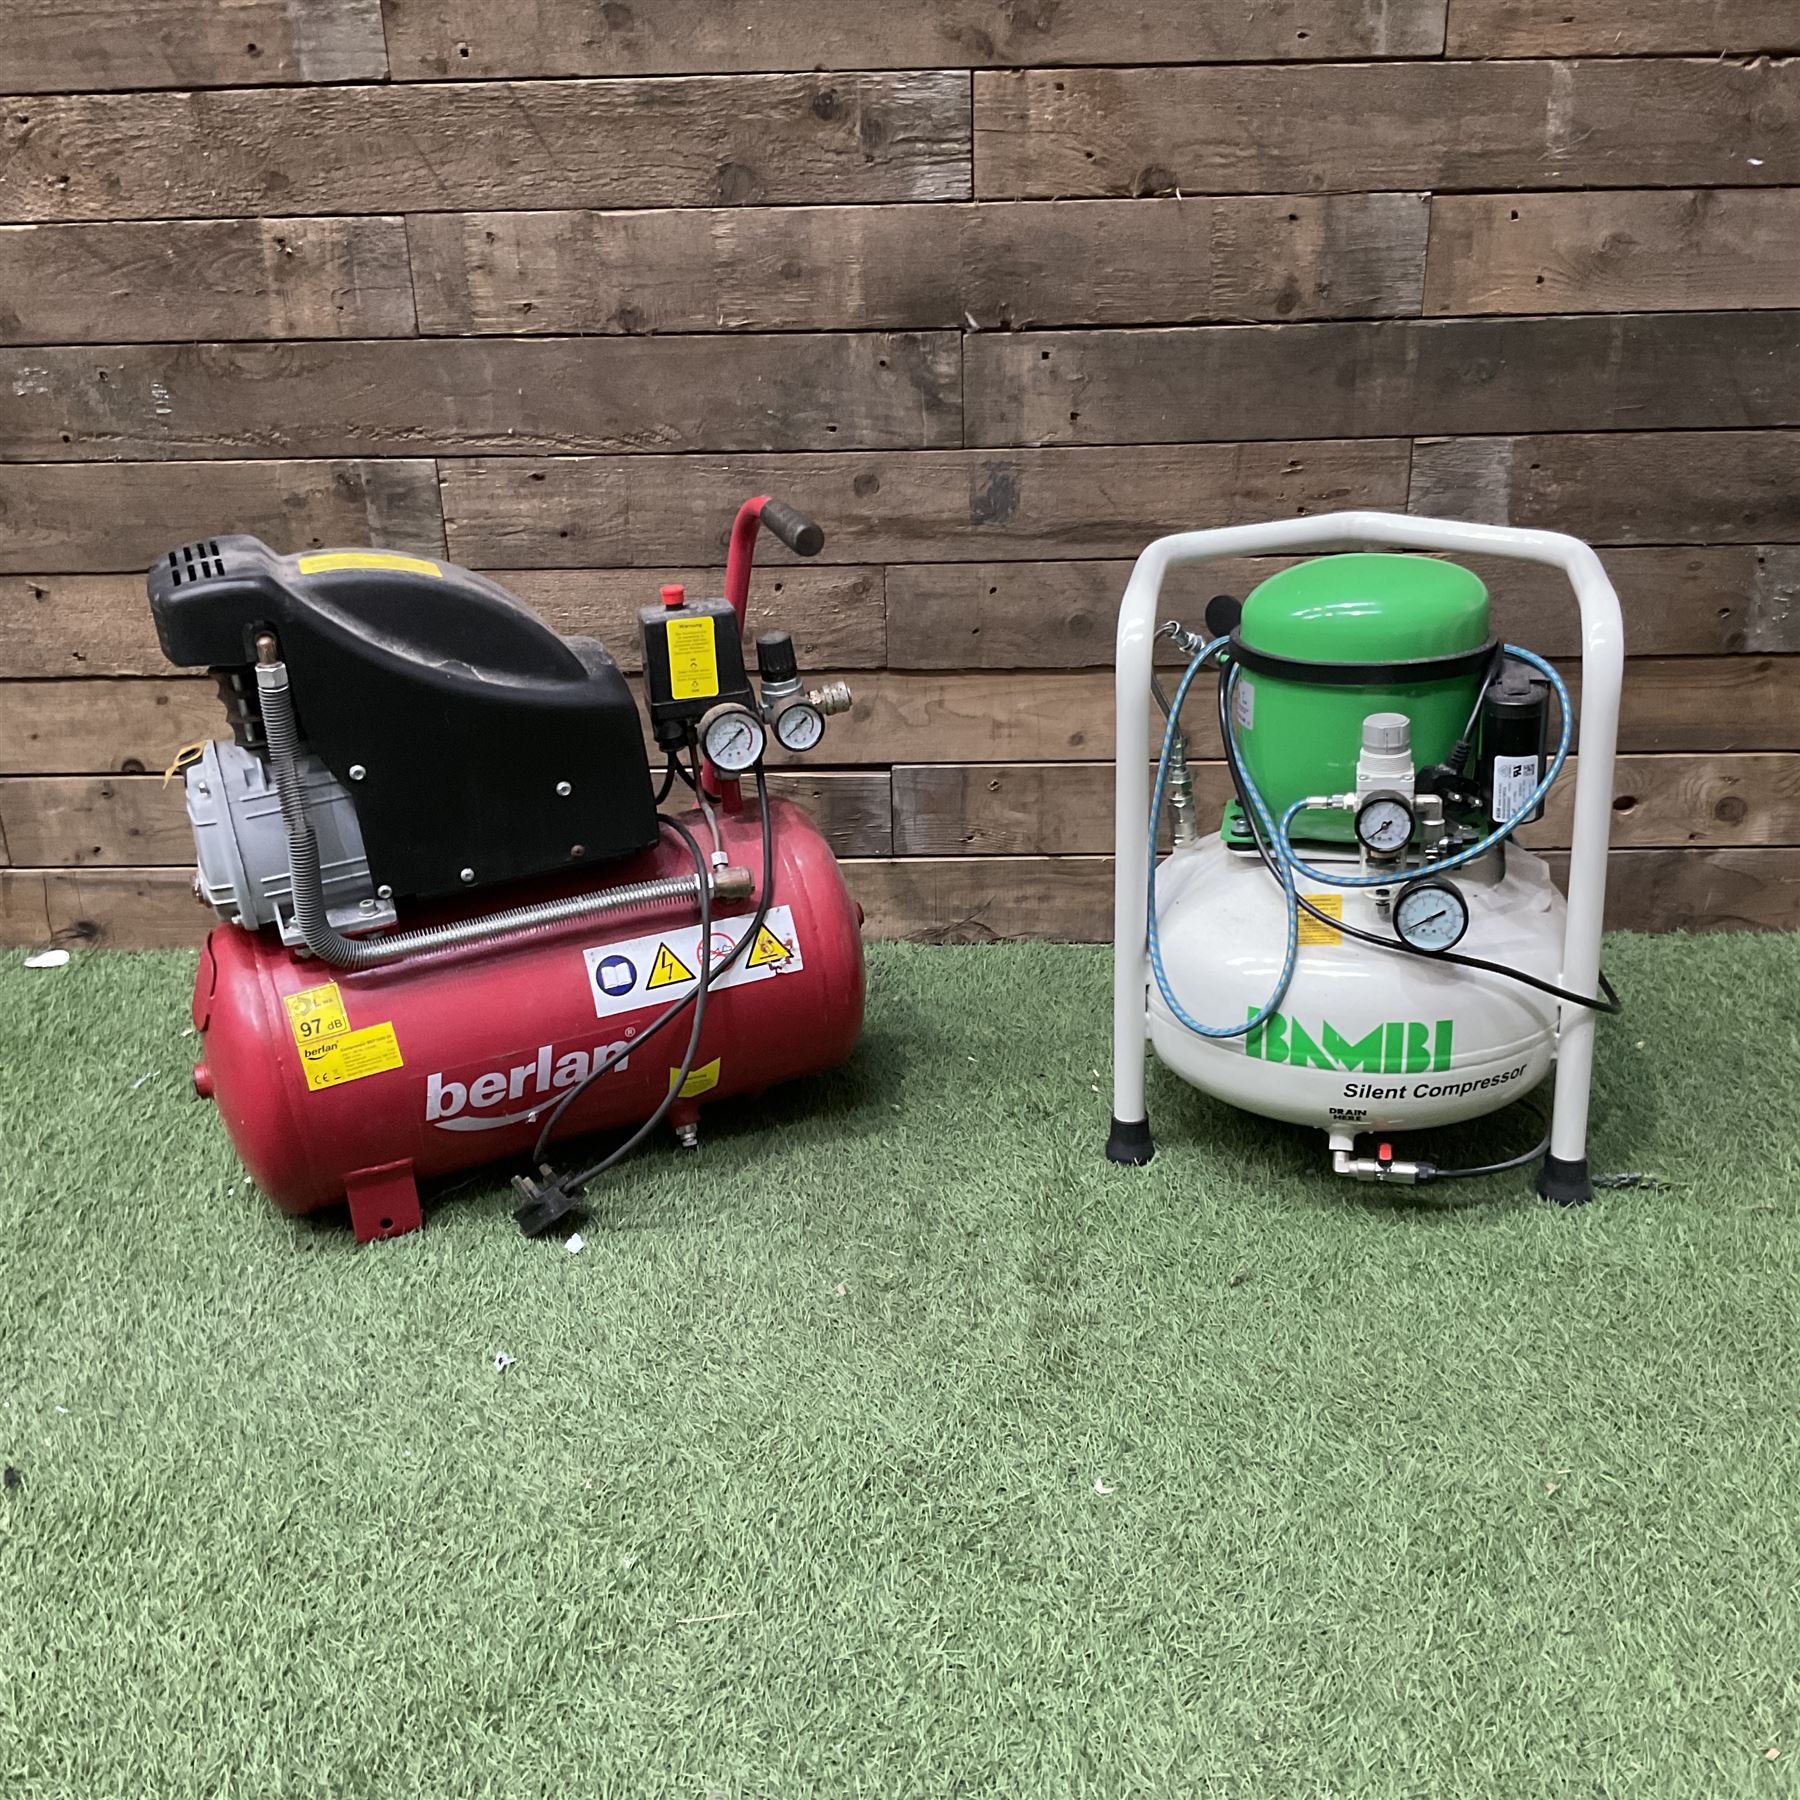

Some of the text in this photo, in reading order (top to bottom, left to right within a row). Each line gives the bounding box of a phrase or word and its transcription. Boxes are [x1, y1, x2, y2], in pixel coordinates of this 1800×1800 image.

[300, 1018, 343, 1037] 97 dB
[1245, 1005, 1453, 1074] BAMBI
[304, 1042, 338, 1058] berlan
[426, 1040, 629, 1121] berlan
[1343, 1063, 1528, 1100] Silent Compressor
[1328, 1107, 1367, 1117] DRAIN
